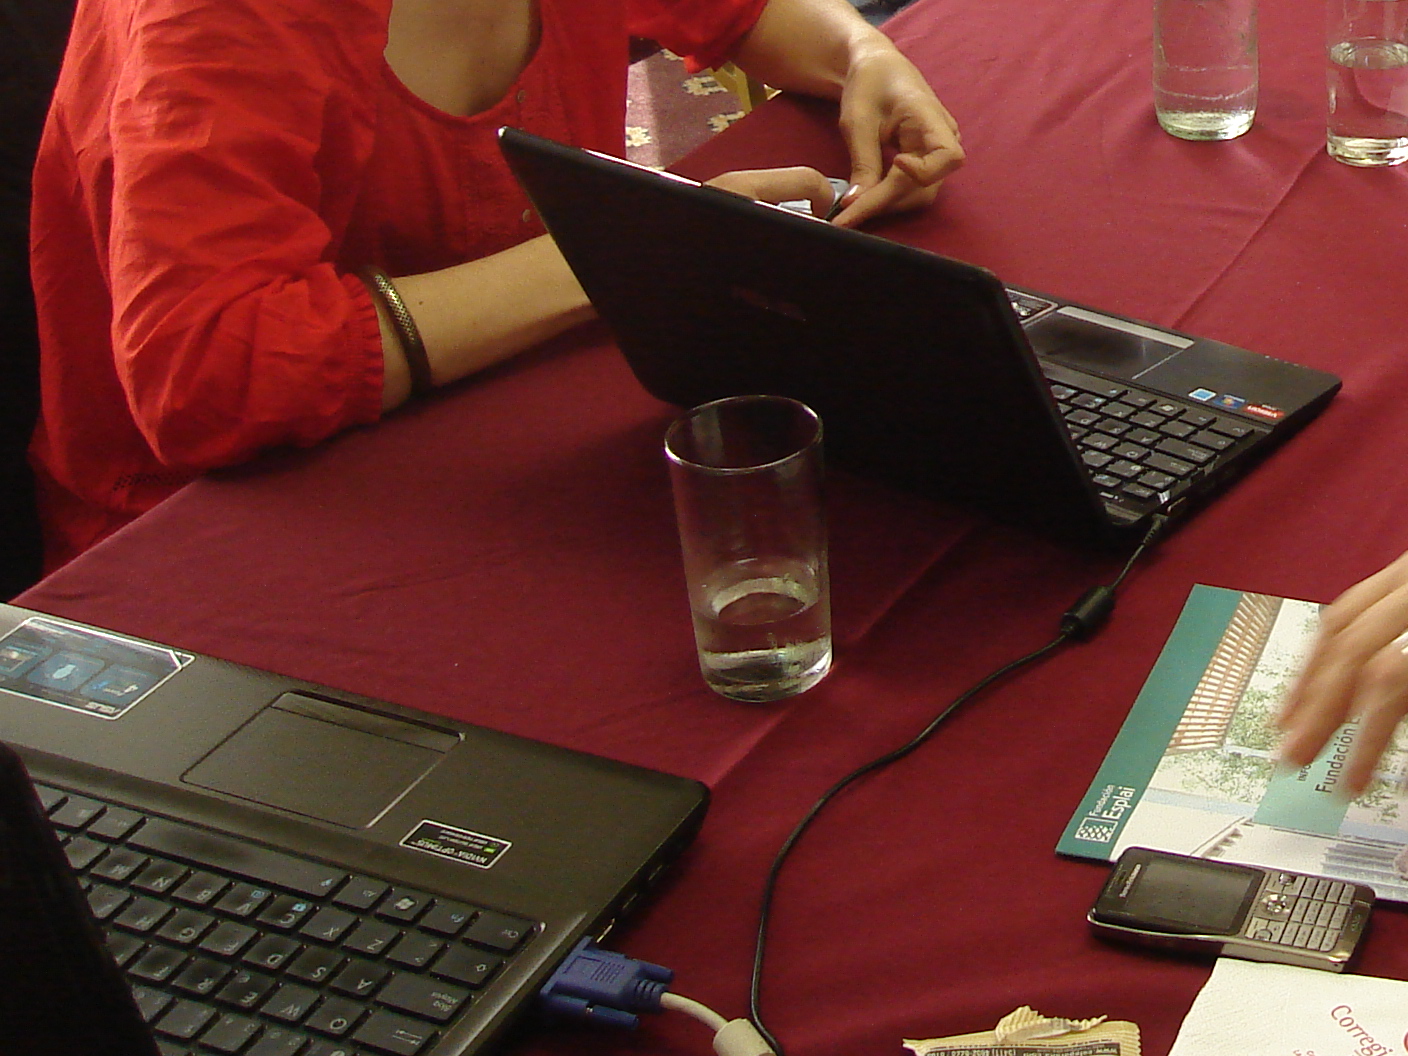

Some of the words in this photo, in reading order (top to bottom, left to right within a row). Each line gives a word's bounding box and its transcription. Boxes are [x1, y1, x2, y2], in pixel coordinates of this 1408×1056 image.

[1315, 727, 1357, 794] Fundación
[1089, 785, 1115, 817] Fundación
[1101, 786, 1136, 820] Esplai
